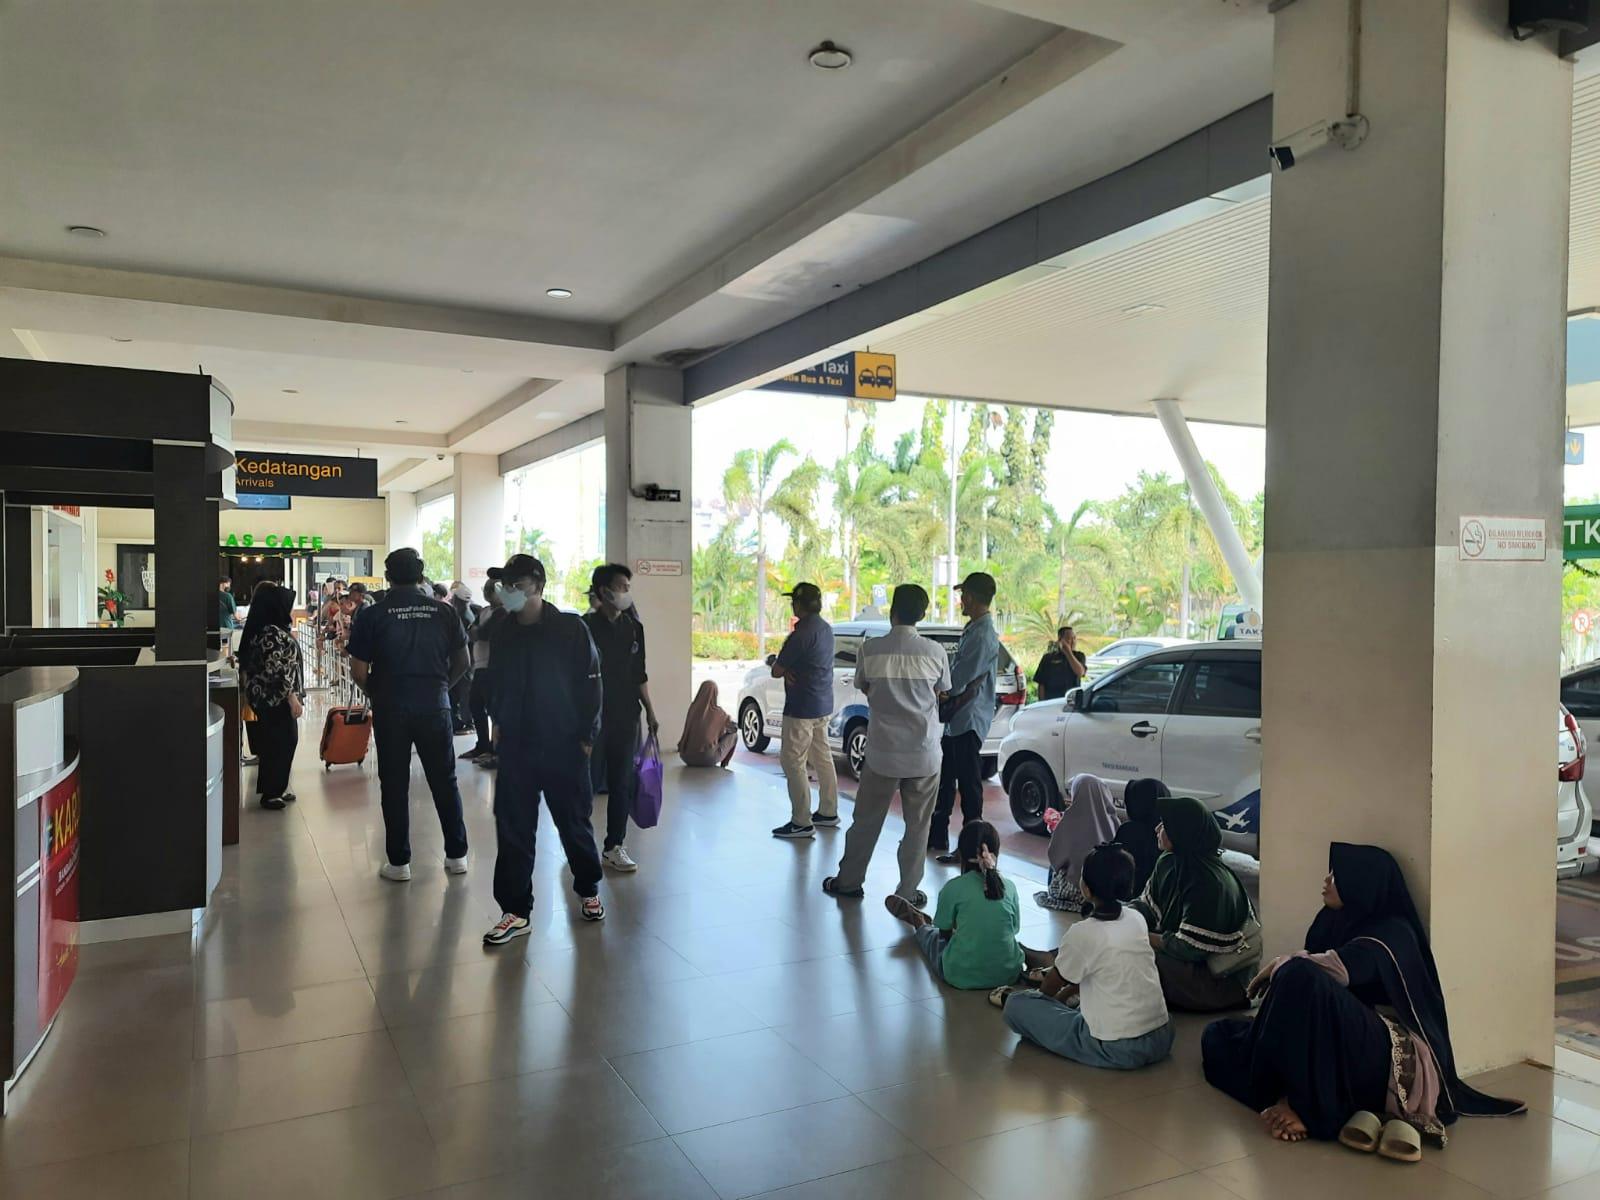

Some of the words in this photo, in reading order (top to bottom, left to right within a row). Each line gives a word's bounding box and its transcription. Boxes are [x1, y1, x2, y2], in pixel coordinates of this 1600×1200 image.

[822, 361, 849, 374] Taxi
[801, 375, 816, 383] Bus
[826, 376, 843, 386] Taxi
[235, 457, 342, 480] Kedatangan
[225, 533, 254, 548] AS
[265, 534, 323, 550] CAFE
